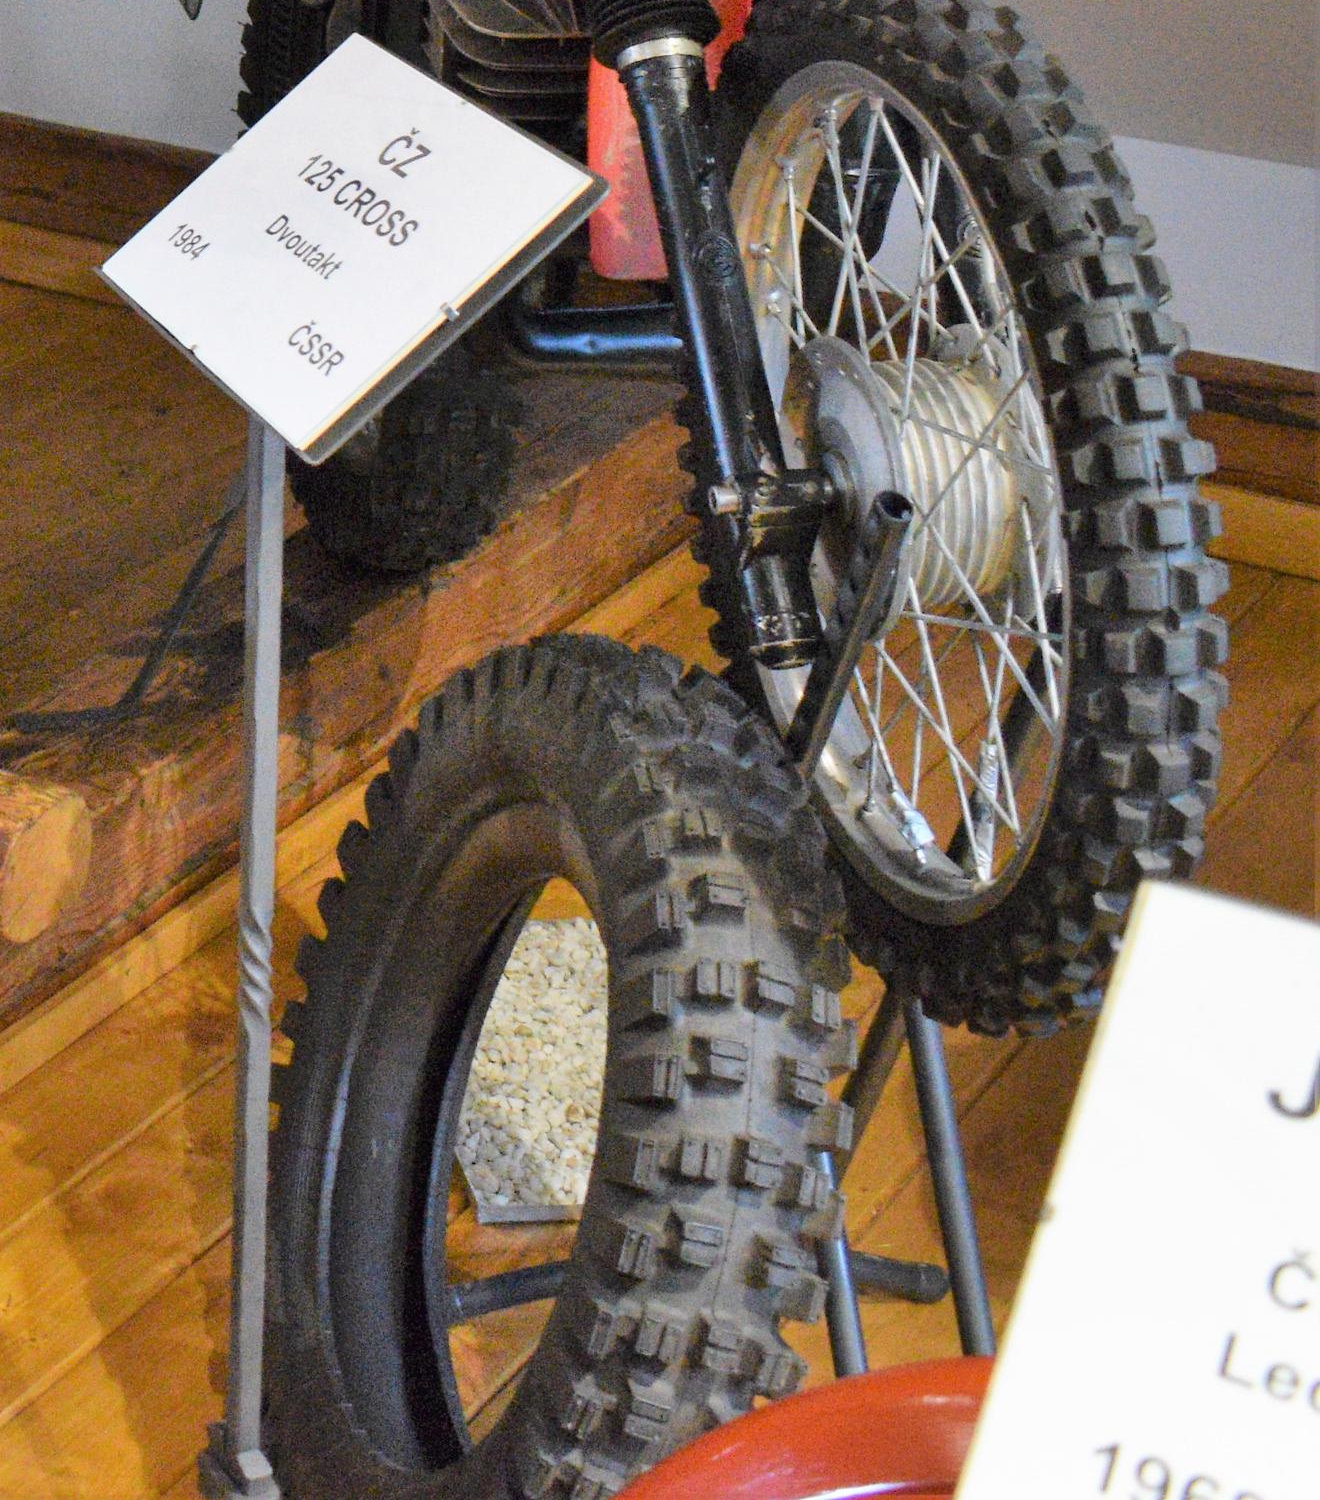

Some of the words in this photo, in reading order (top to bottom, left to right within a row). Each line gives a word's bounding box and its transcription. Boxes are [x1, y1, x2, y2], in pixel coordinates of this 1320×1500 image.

[378, 127, 432, 179] ČZ
[297, 153, 345, 193] 125
[333, 179, 420, 248] CROSS
[167, 222, 211, 261] 1984
[265, 214, 344, 280] Dvoutakt
[288, 320, 345, 377] ČSSR
[1094, 1443, 1264, 1500] 196
